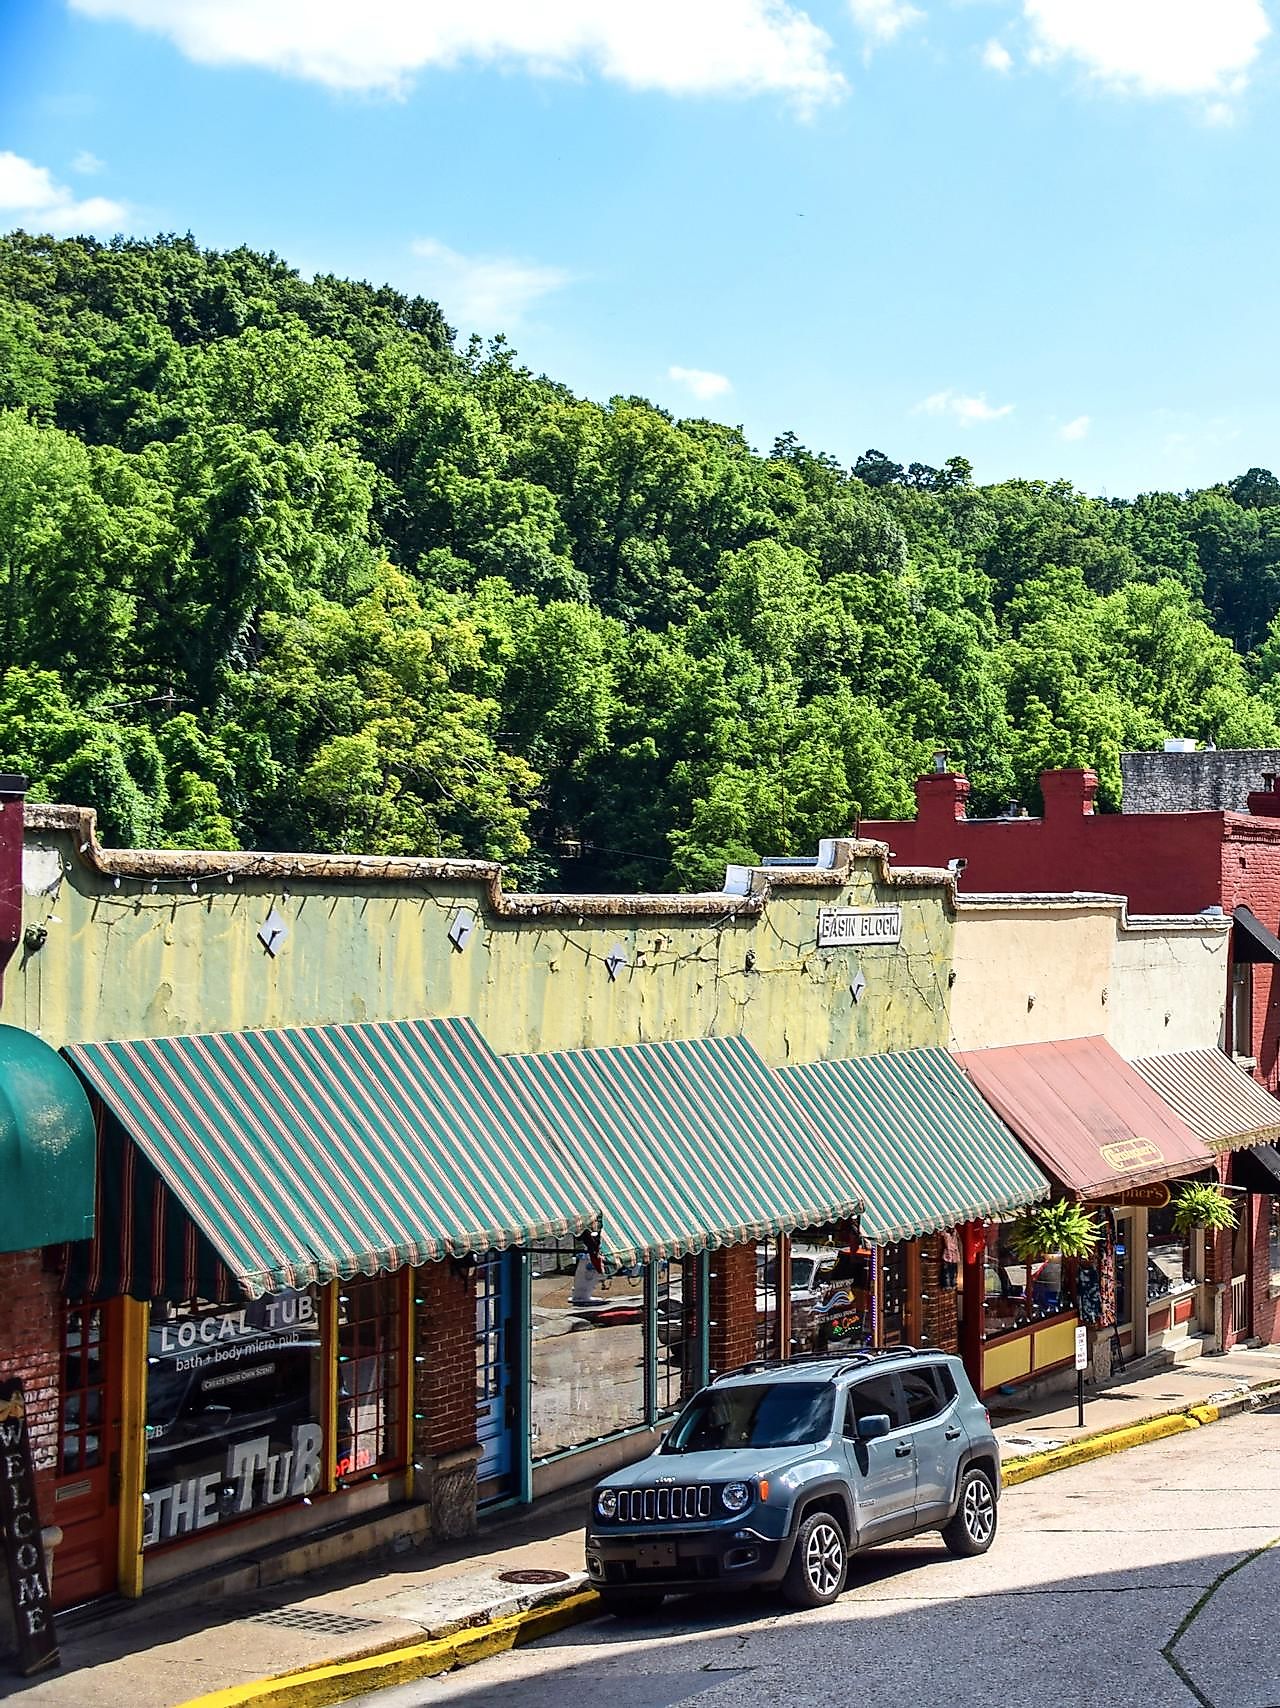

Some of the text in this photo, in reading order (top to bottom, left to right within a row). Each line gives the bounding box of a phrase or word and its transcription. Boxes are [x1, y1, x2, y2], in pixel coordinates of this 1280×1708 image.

[822, 916, 898, 937] BASIN BLOCK
[161, 1296, 314, 1352] LOCAL TUB
[176, 1352, 203, 1372] bath
[215, 1343, 244, 1364] body
[244, 1334, 275, 1355] micro
[278, 1331, 300, 1351] pub
[144, 1423, 324, 1547] THE TUB
[0, 1422, 48, 1635] WELCOME
